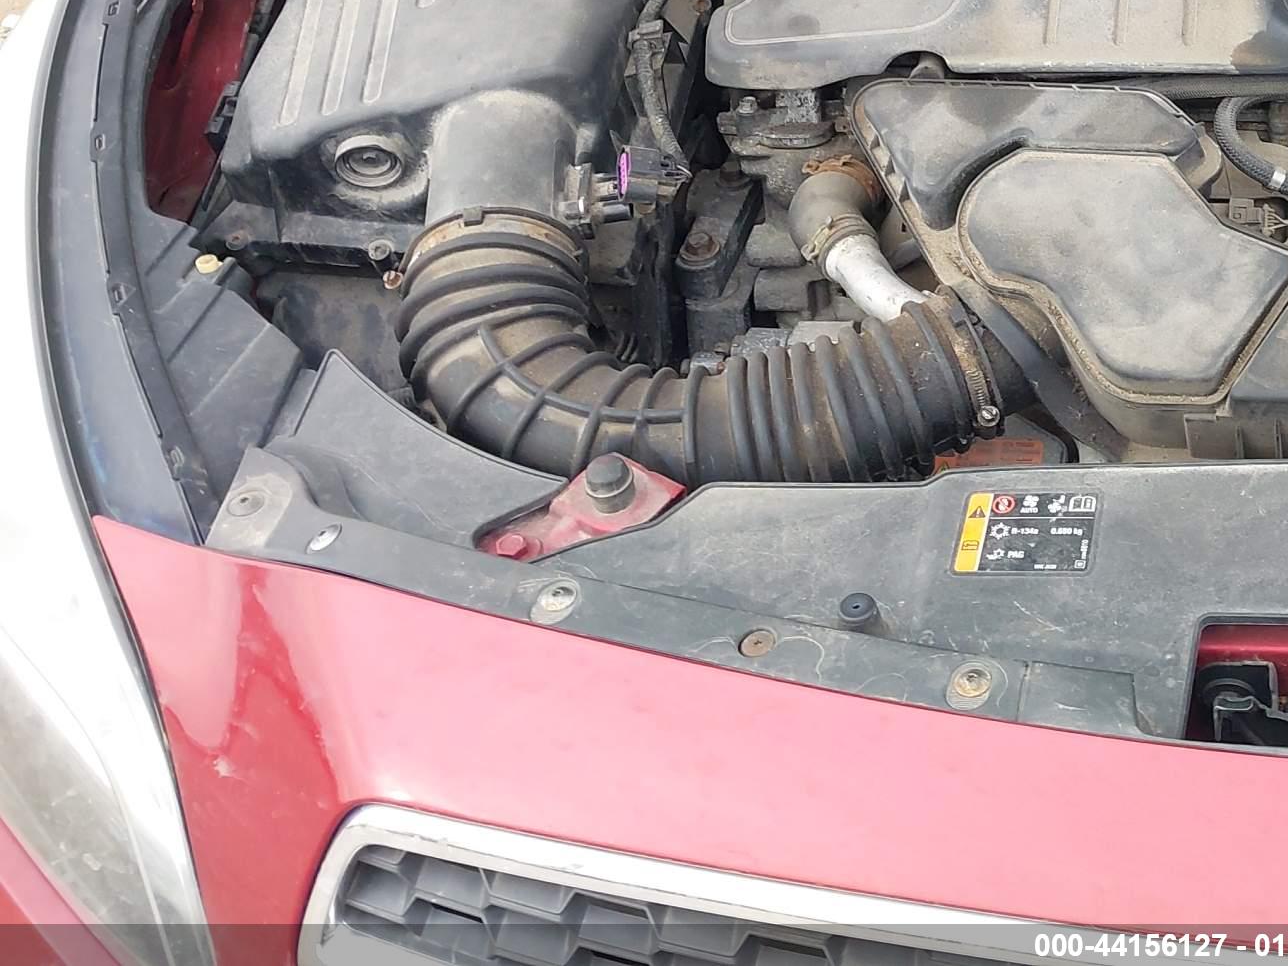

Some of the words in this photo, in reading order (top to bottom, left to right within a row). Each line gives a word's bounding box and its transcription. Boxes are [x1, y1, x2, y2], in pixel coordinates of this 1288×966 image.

[1010, 527, 1039, 535] R-134a
[1073, 527, 1083, 536] kg
[1007, 550, 1025, 559] PAG
